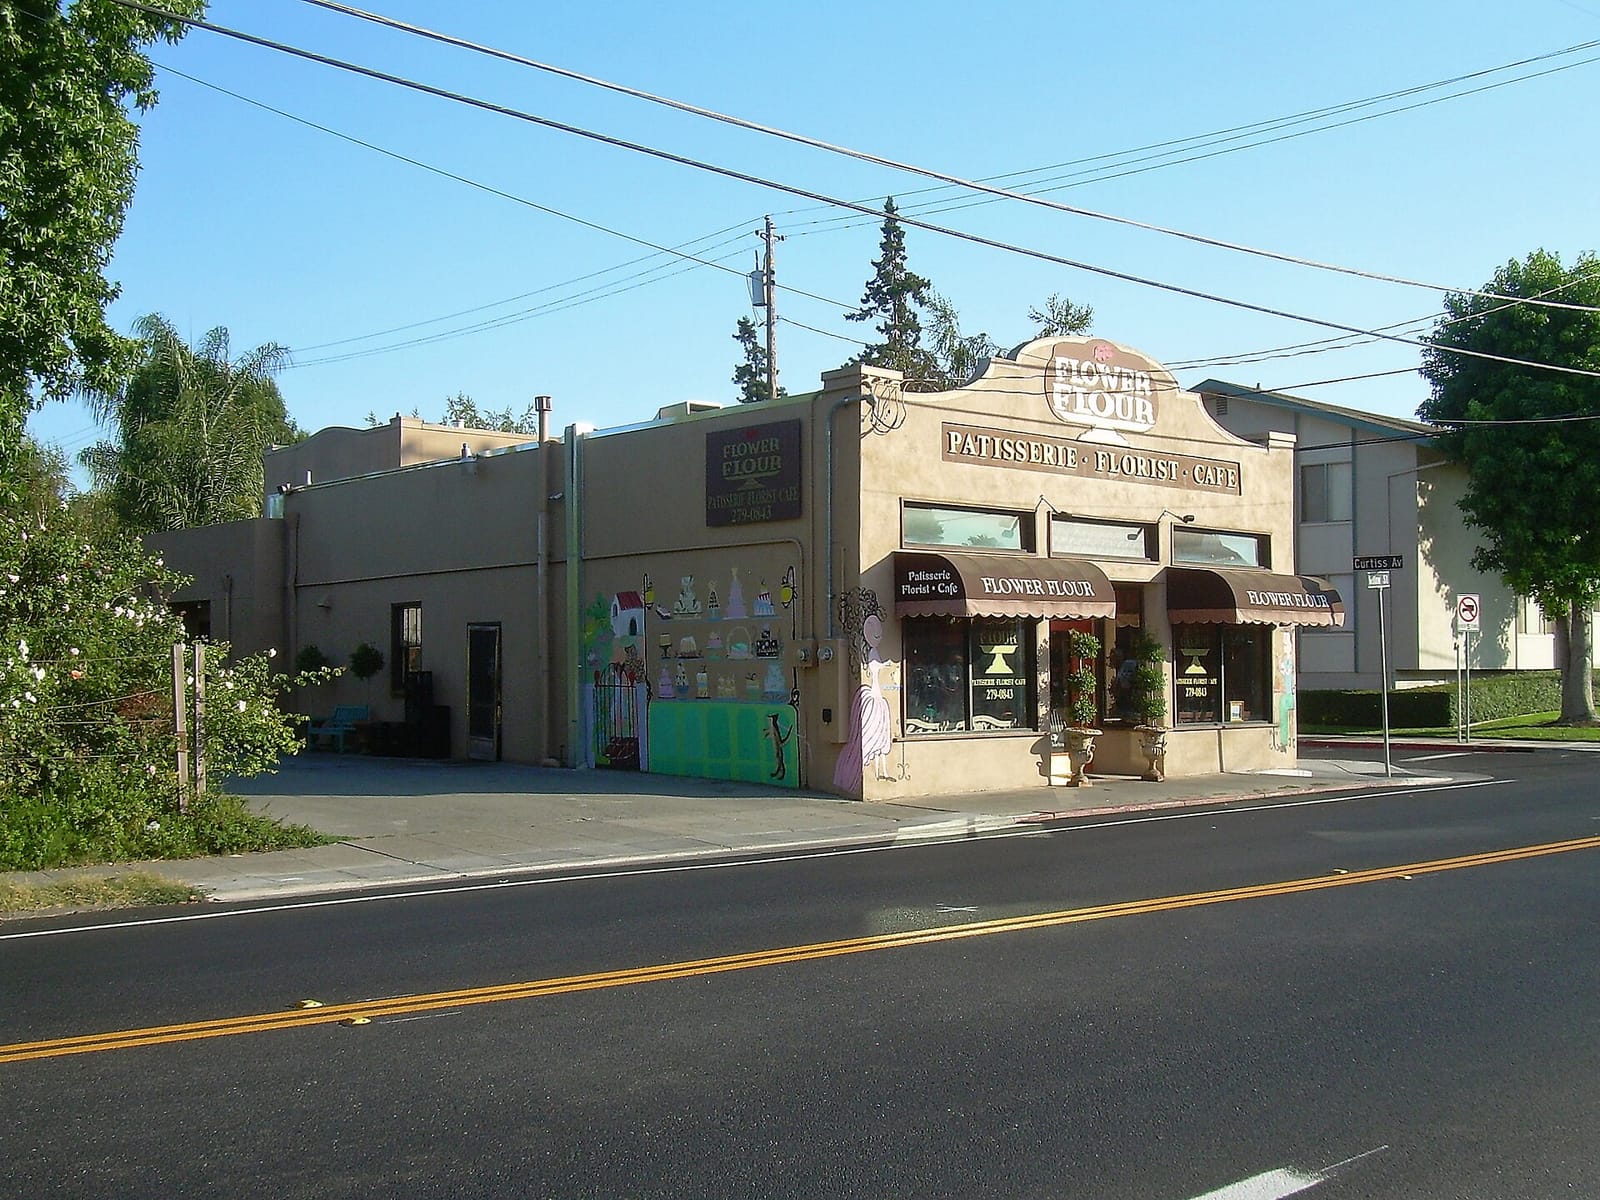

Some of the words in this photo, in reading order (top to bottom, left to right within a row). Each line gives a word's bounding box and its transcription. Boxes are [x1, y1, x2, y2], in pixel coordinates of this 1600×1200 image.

[1053, 356, 1151, 396] FLOWER
[1052, 382, 1154, 425] FLOUR
[723, 437, 780, 458] FLOWER
[722, 455, 782, 476] FLOUR
[946, 431, 1078, 469] PATISSERIE
[1095, 450, 1179, 481] FLORIST
[1193, 464, 1237, 488] CAFE
[1354, 558, 1388, 569] Curtiss
[1391, 557, 1402, 568] Av
[908, 569, 951, 582] Patisserie
[901, 582, 930, 595] Florist
[937, 582, 958, 596] Cafe
[980, 577, 1044, 595] FLOWER
[1045, 580, 1096, 597] FLOUR
[1247, 590, 1296, 608] FLOWER
[1295, 593, 1330, 608] FLOUR
